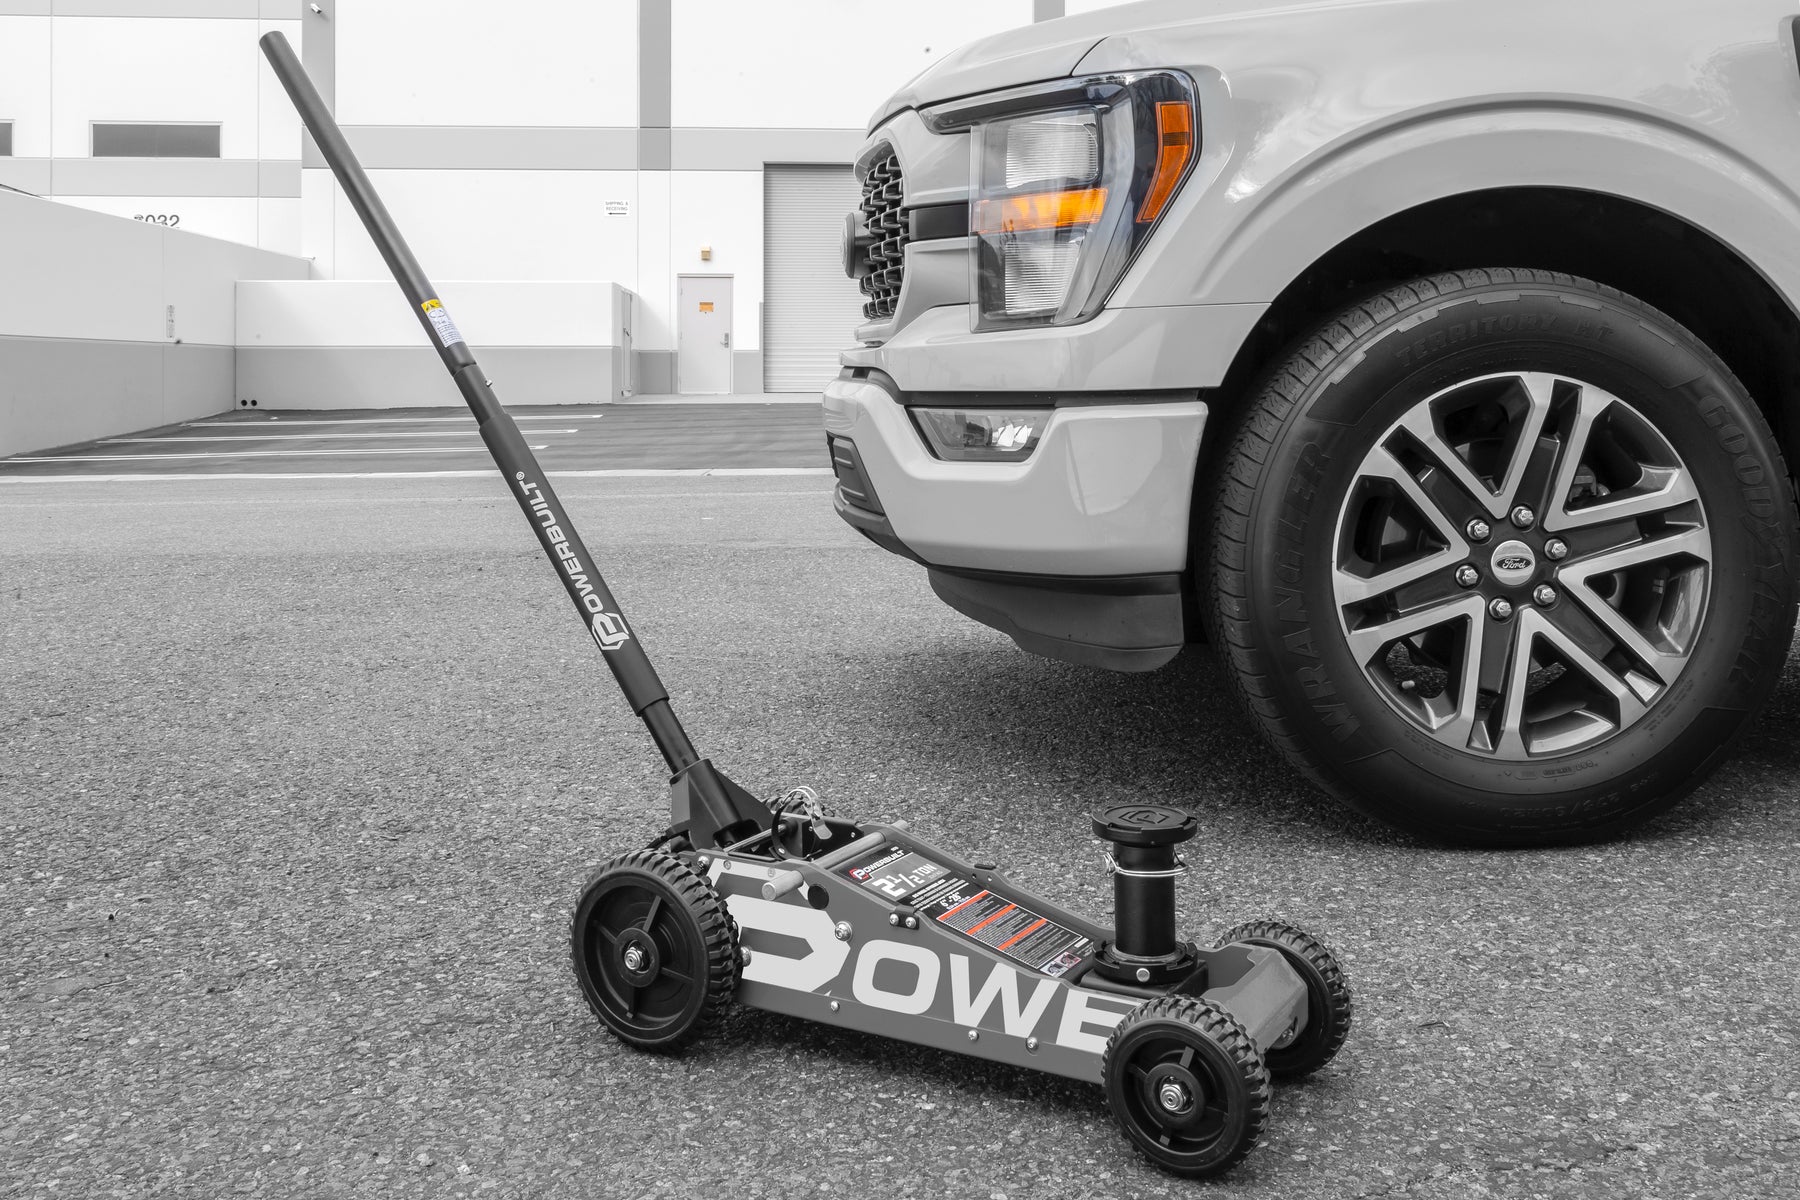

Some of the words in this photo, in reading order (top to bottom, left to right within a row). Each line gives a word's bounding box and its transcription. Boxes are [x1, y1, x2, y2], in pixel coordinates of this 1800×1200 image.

[1502, 558, 1526, 569] Ford
[1271, 440, 1361, 742] WRANGLER
[912, 863, 937, 878] TON
